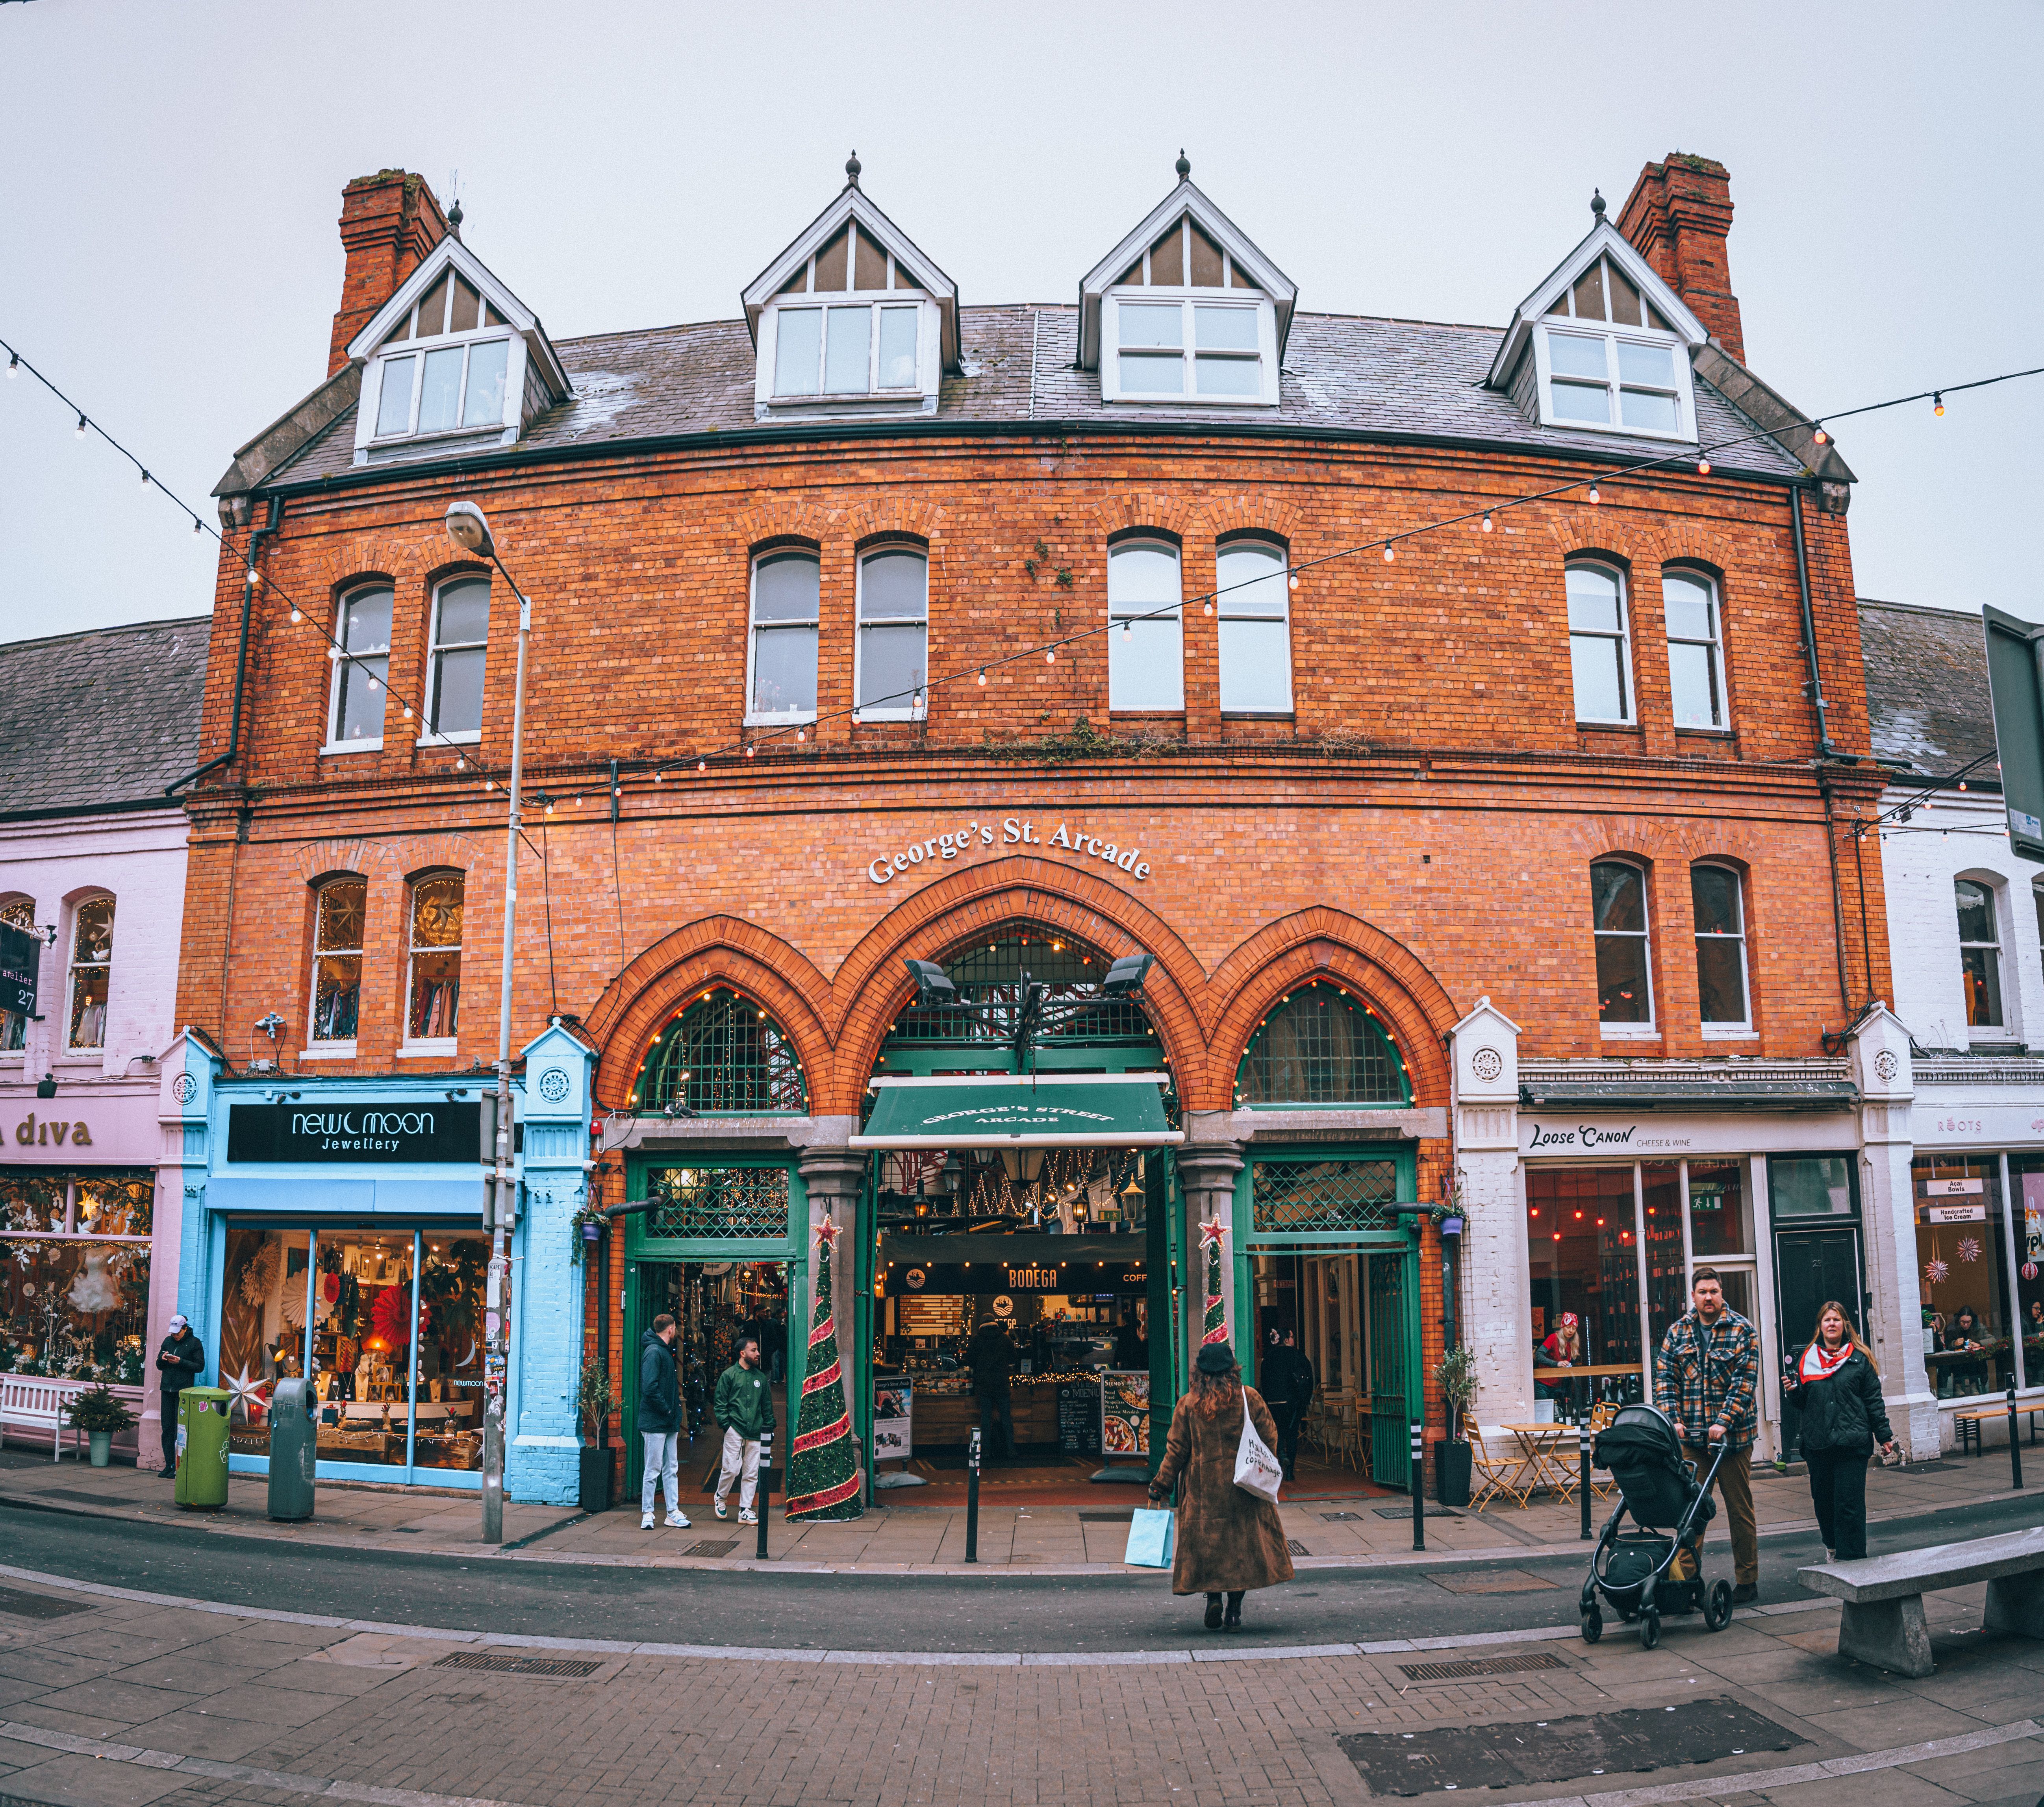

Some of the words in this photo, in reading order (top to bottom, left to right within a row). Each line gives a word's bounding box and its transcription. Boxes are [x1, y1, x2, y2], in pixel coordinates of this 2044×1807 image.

[868, 822, 993, 884] George's
[1003, 818, 1040, 844] St.
[1048, 822, 1150, 880] Arcade
[2, 970, 32, 985] atelier
[18, 989, 35, 1011] 27
[293, 1113, 343, 1134] new
[363, 1113, 434, 1134] moon
[922, 1106, 1028, 1124] GEORGE'S
[1035, 1107, 1115, 1121] STREET
[16, 1112, 93, 1144] diva
[1529, 1124, 1575, 1149] Loose
[322, 1138, 399, 1151] Jewellery
[1009, 1269, 1057, 1288] BODEGA
[1072, 1388, 1100, 1398] MENU
[1249, 1448, 1261, 1459] from
